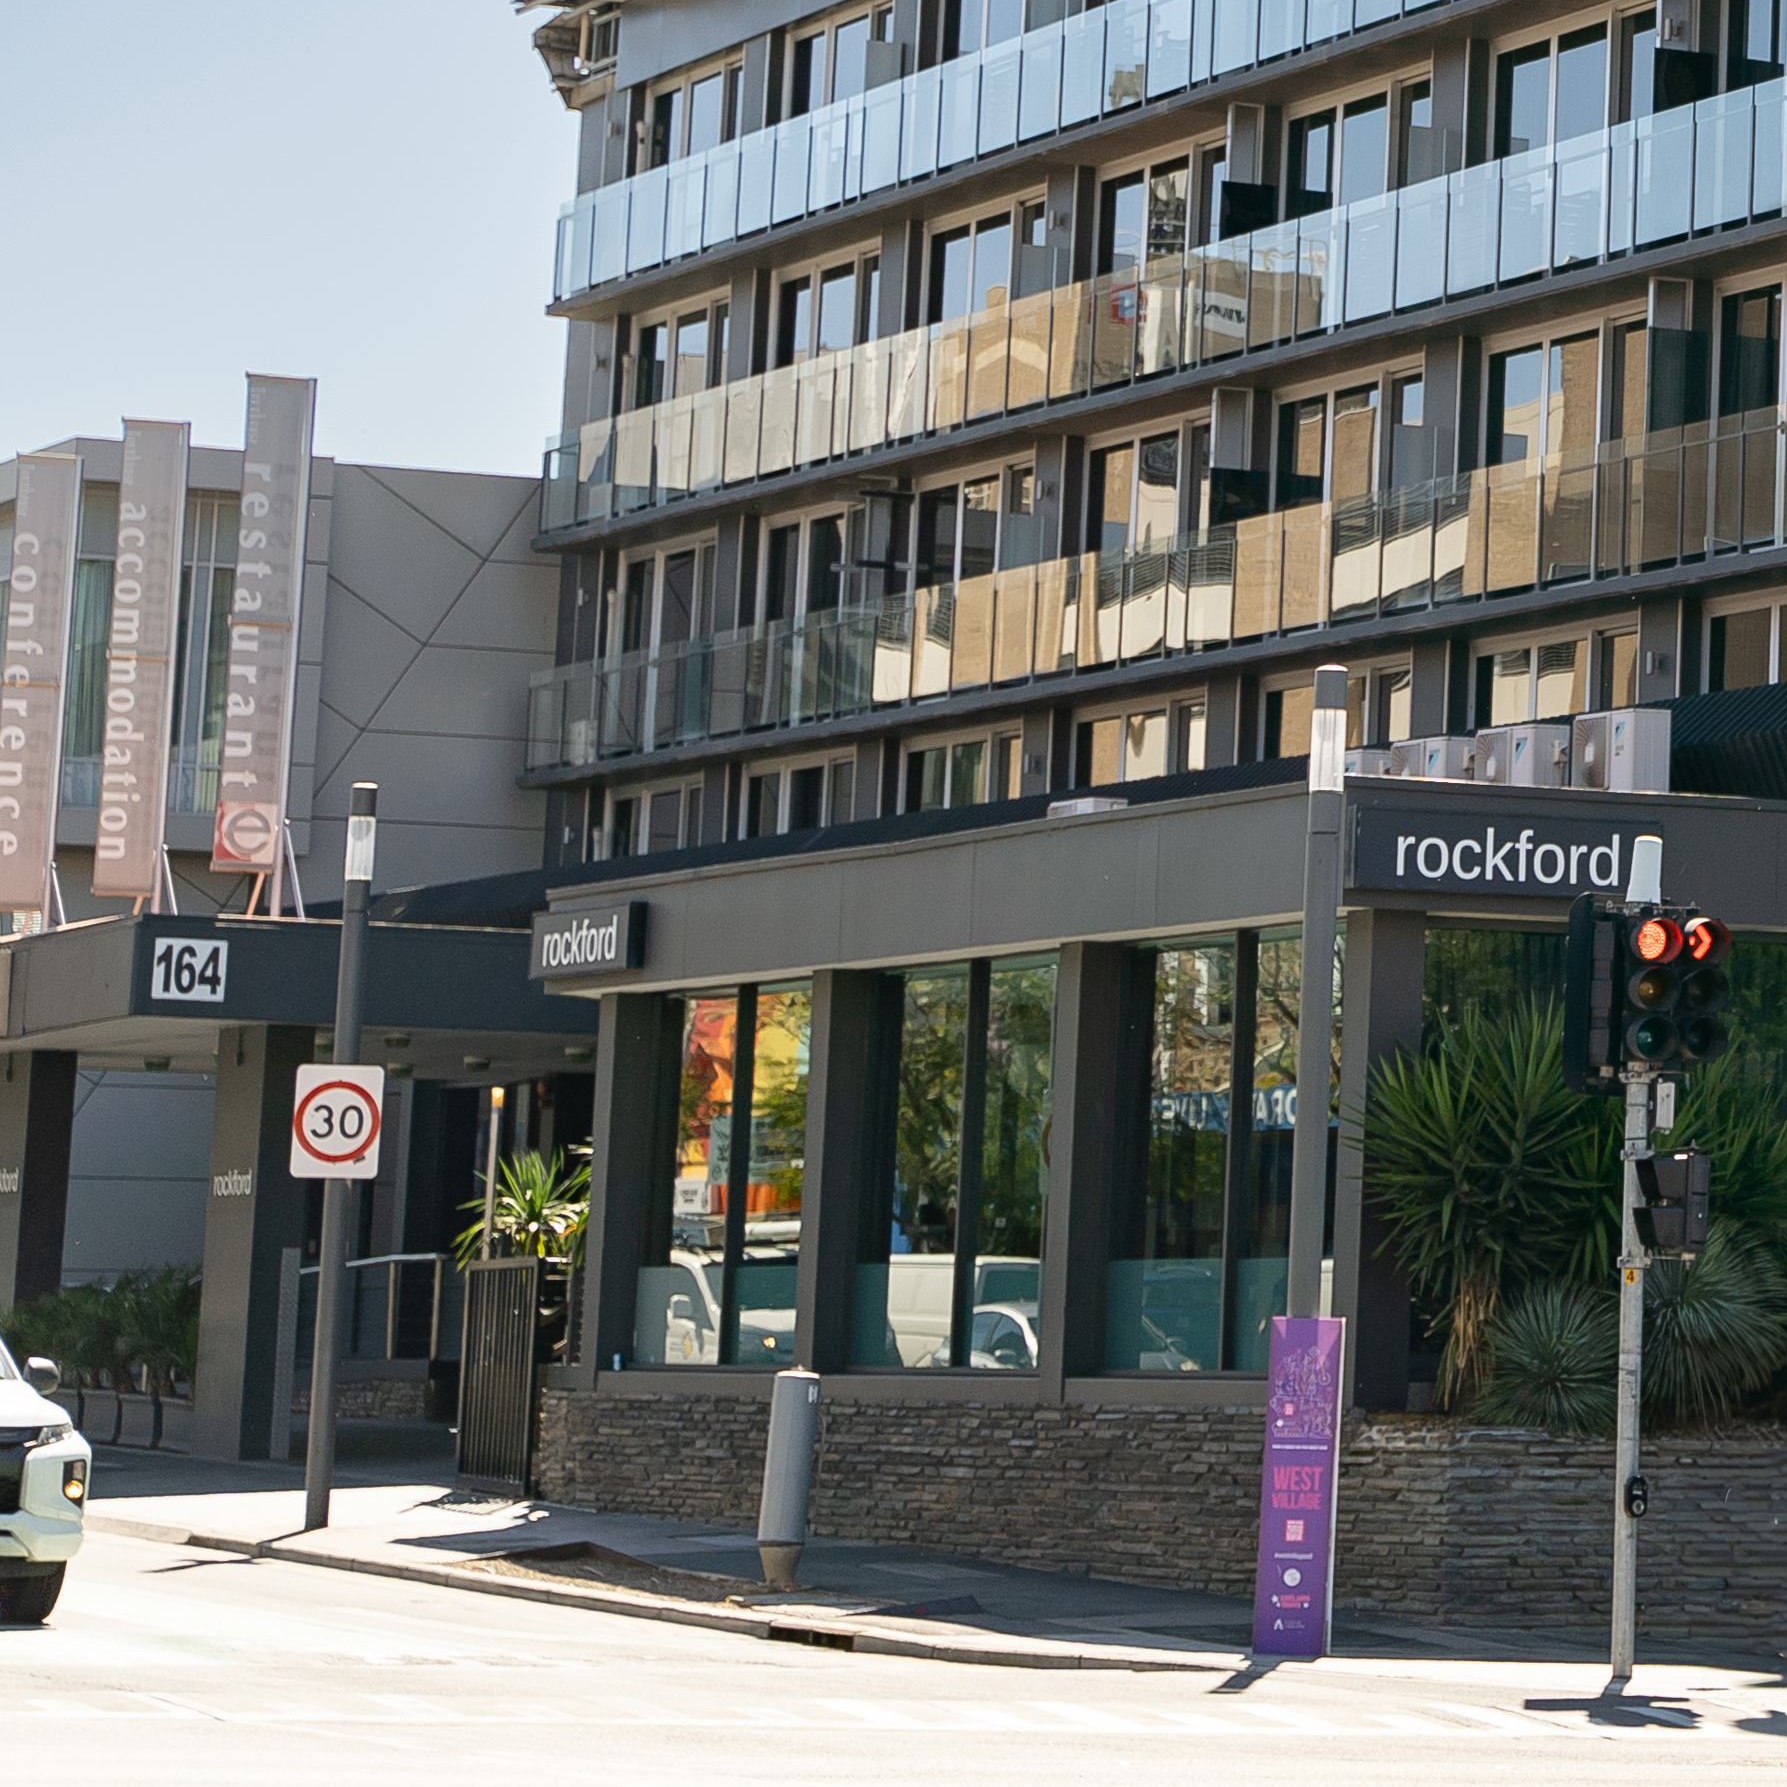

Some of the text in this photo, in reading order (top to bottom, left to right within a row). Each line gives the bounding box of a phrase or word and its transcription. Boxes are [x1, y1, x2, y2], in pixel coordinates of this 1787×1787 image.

[222, 462, 272, 787] restaurant
[0, 532, 43, 856] conference
[98, 501, 147, 860] accommodation
[1396, 827, 1620, 887] rockford
[542, 914, 618, 968] rockford
[157, 944, 221, 996] 164
[310, 1104, 364, 1139] 30
[213, 1168, 253, 1197] rockford
[1626, 1270, 1634, 1283] 4
[1272, 1492, 1322, 1510] VILLAGE
[1273, 1465, 1323, 1491] WEST
